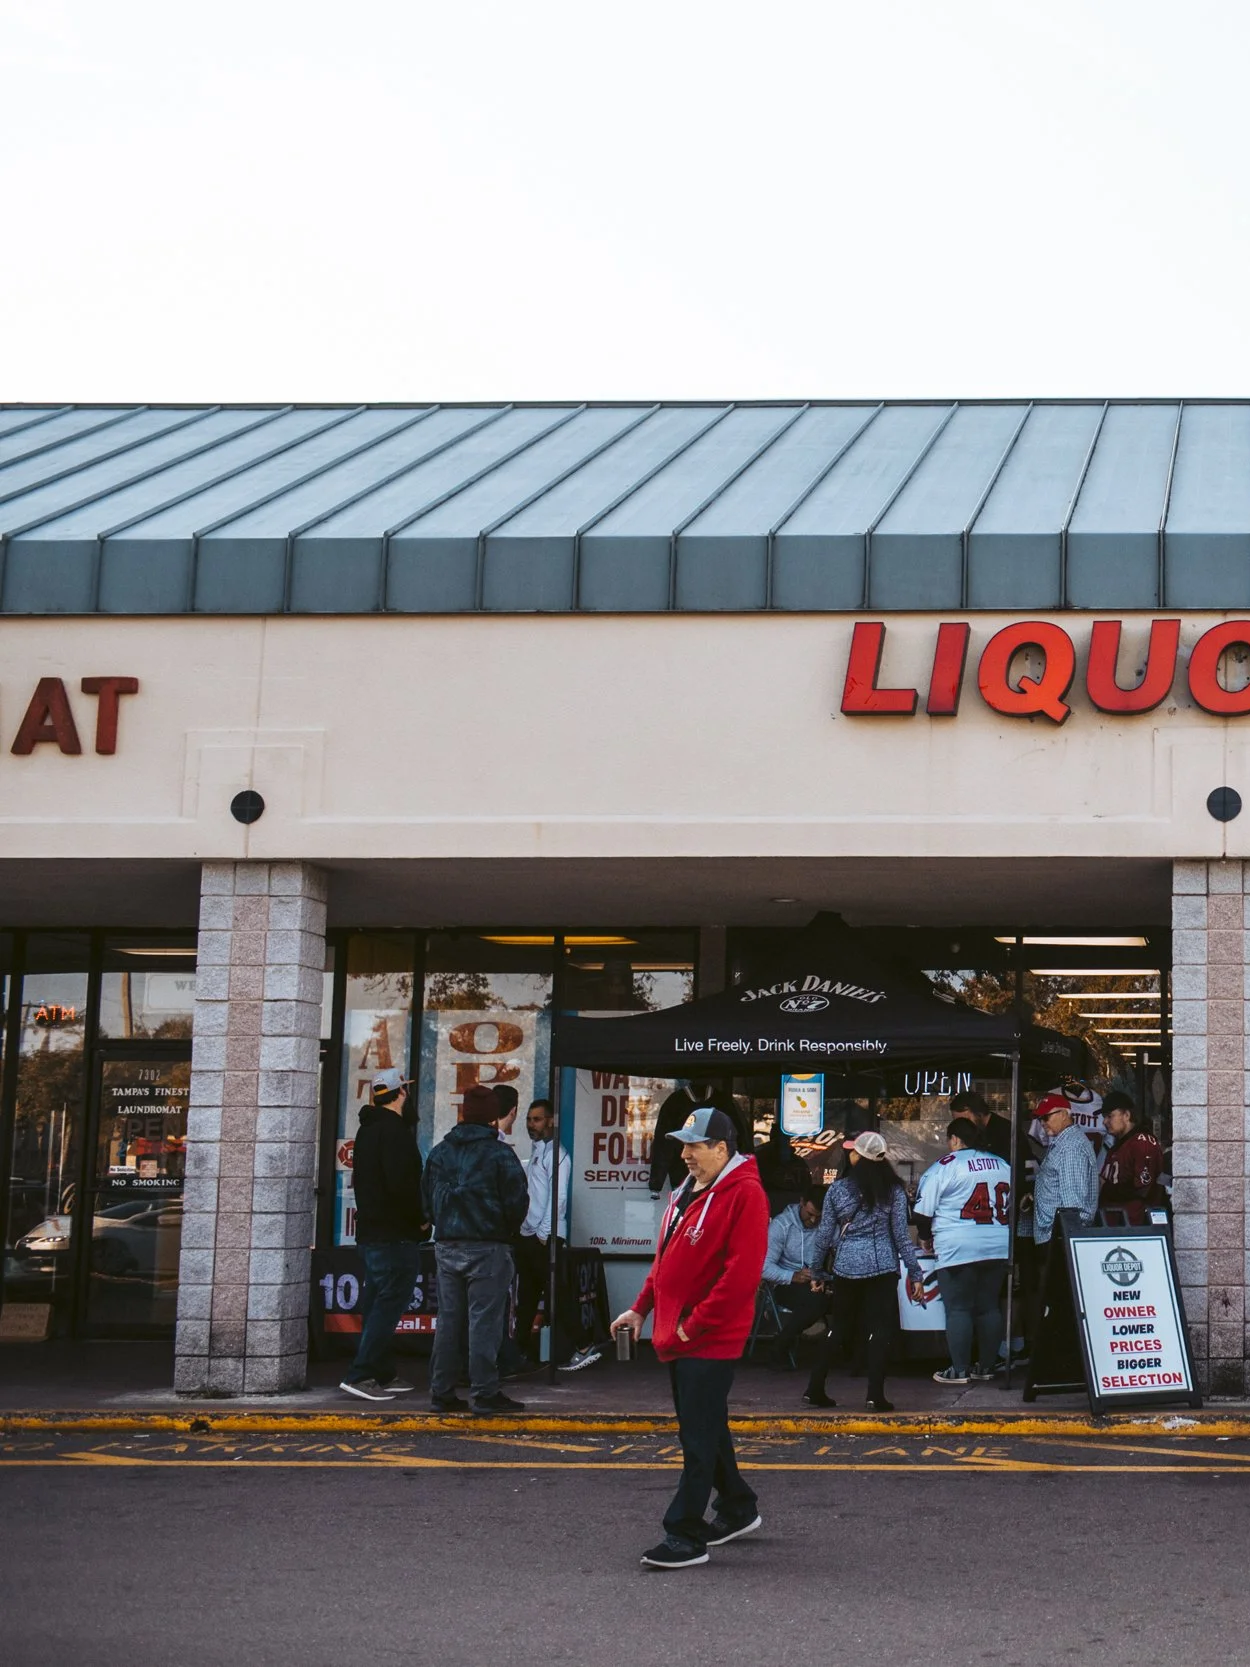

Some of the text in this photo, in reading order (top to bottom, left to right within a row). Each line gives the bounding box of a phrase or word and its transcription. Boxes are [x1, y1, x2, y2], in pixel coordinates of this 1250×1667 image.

[740, 980, 799, 1002] JACK
[35, 1005, 76, 1021] ATM
[675, 1038, 704, 1051] Live
[708, 1038, 753, 1055] Freely.
[758, 1038, 796, 1051] Drink
[138, 1069, 161, 1081] 7302
[112, 1087, 190, 1097] TAMPA'S FINEST
[118, 1105, 182, 1115] LAUNDROMAT
[1071, 1112, 1099, 1128] STOTT
[967, 1158, 1000, 1173] ALSTOTT
[584, 1170, 651, 1182] SERVIC
[111, 1179, 127, 1187] NO
[960, 1181, 1011, 1225] 40
[611, 1237, 652, 1246] Minimum
[1102, 1261, 1143, 1273] LIQUOR DEPOT
[1113, 1290, 1141, 1301] NEW
[1103, 1305, 1156, 1319] OWNER
[395, 1317, 426, 1331] eal.
[1112, 1323, 1155, 1336] LOWER
[1109, 1338, 1163, 1353] PRICES
[1117, 1357, 1162, 1370] BIGGER
[1101, 1372, 1183, 1388] SELECTION
[610, 1444, 772, 1455] FIE
[814, 1445, 1012, 1456] LANE
